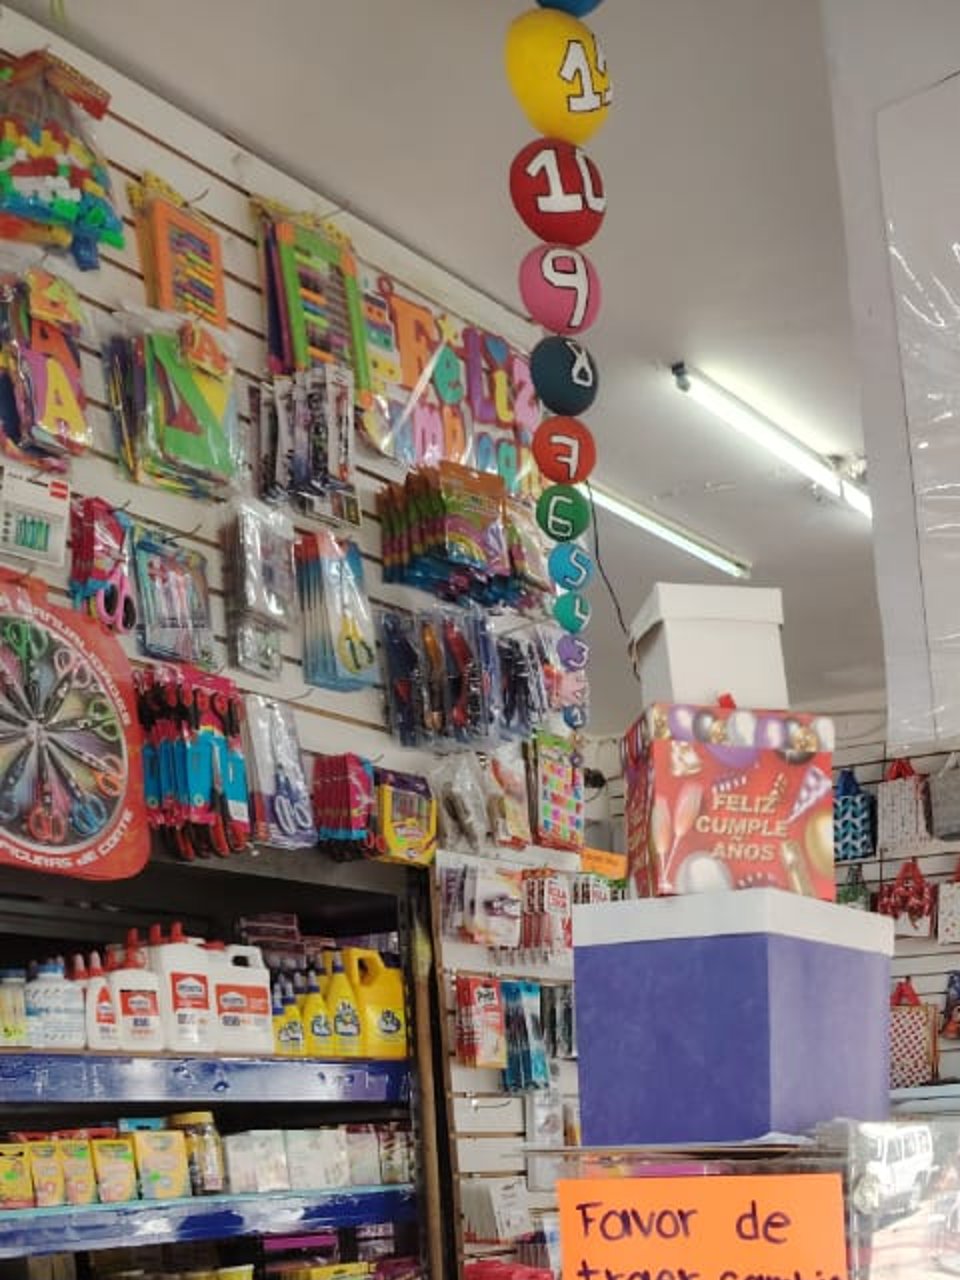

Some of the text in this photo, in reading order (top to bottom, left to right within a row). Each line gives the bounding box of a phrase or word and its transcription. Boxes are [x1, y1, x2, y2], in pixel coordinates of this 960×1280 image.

[541, 247, 590, 322] 9
[548, 495, 574, 538] 6
[565, 549, 589, 587] 5
[712, 793, 778, 814] FELIZ
[695, 815, 788, 838] CUMPLE
[711, 835, 776, 861] AÑOS
[576, 1200, 791, 1245] Favor de
